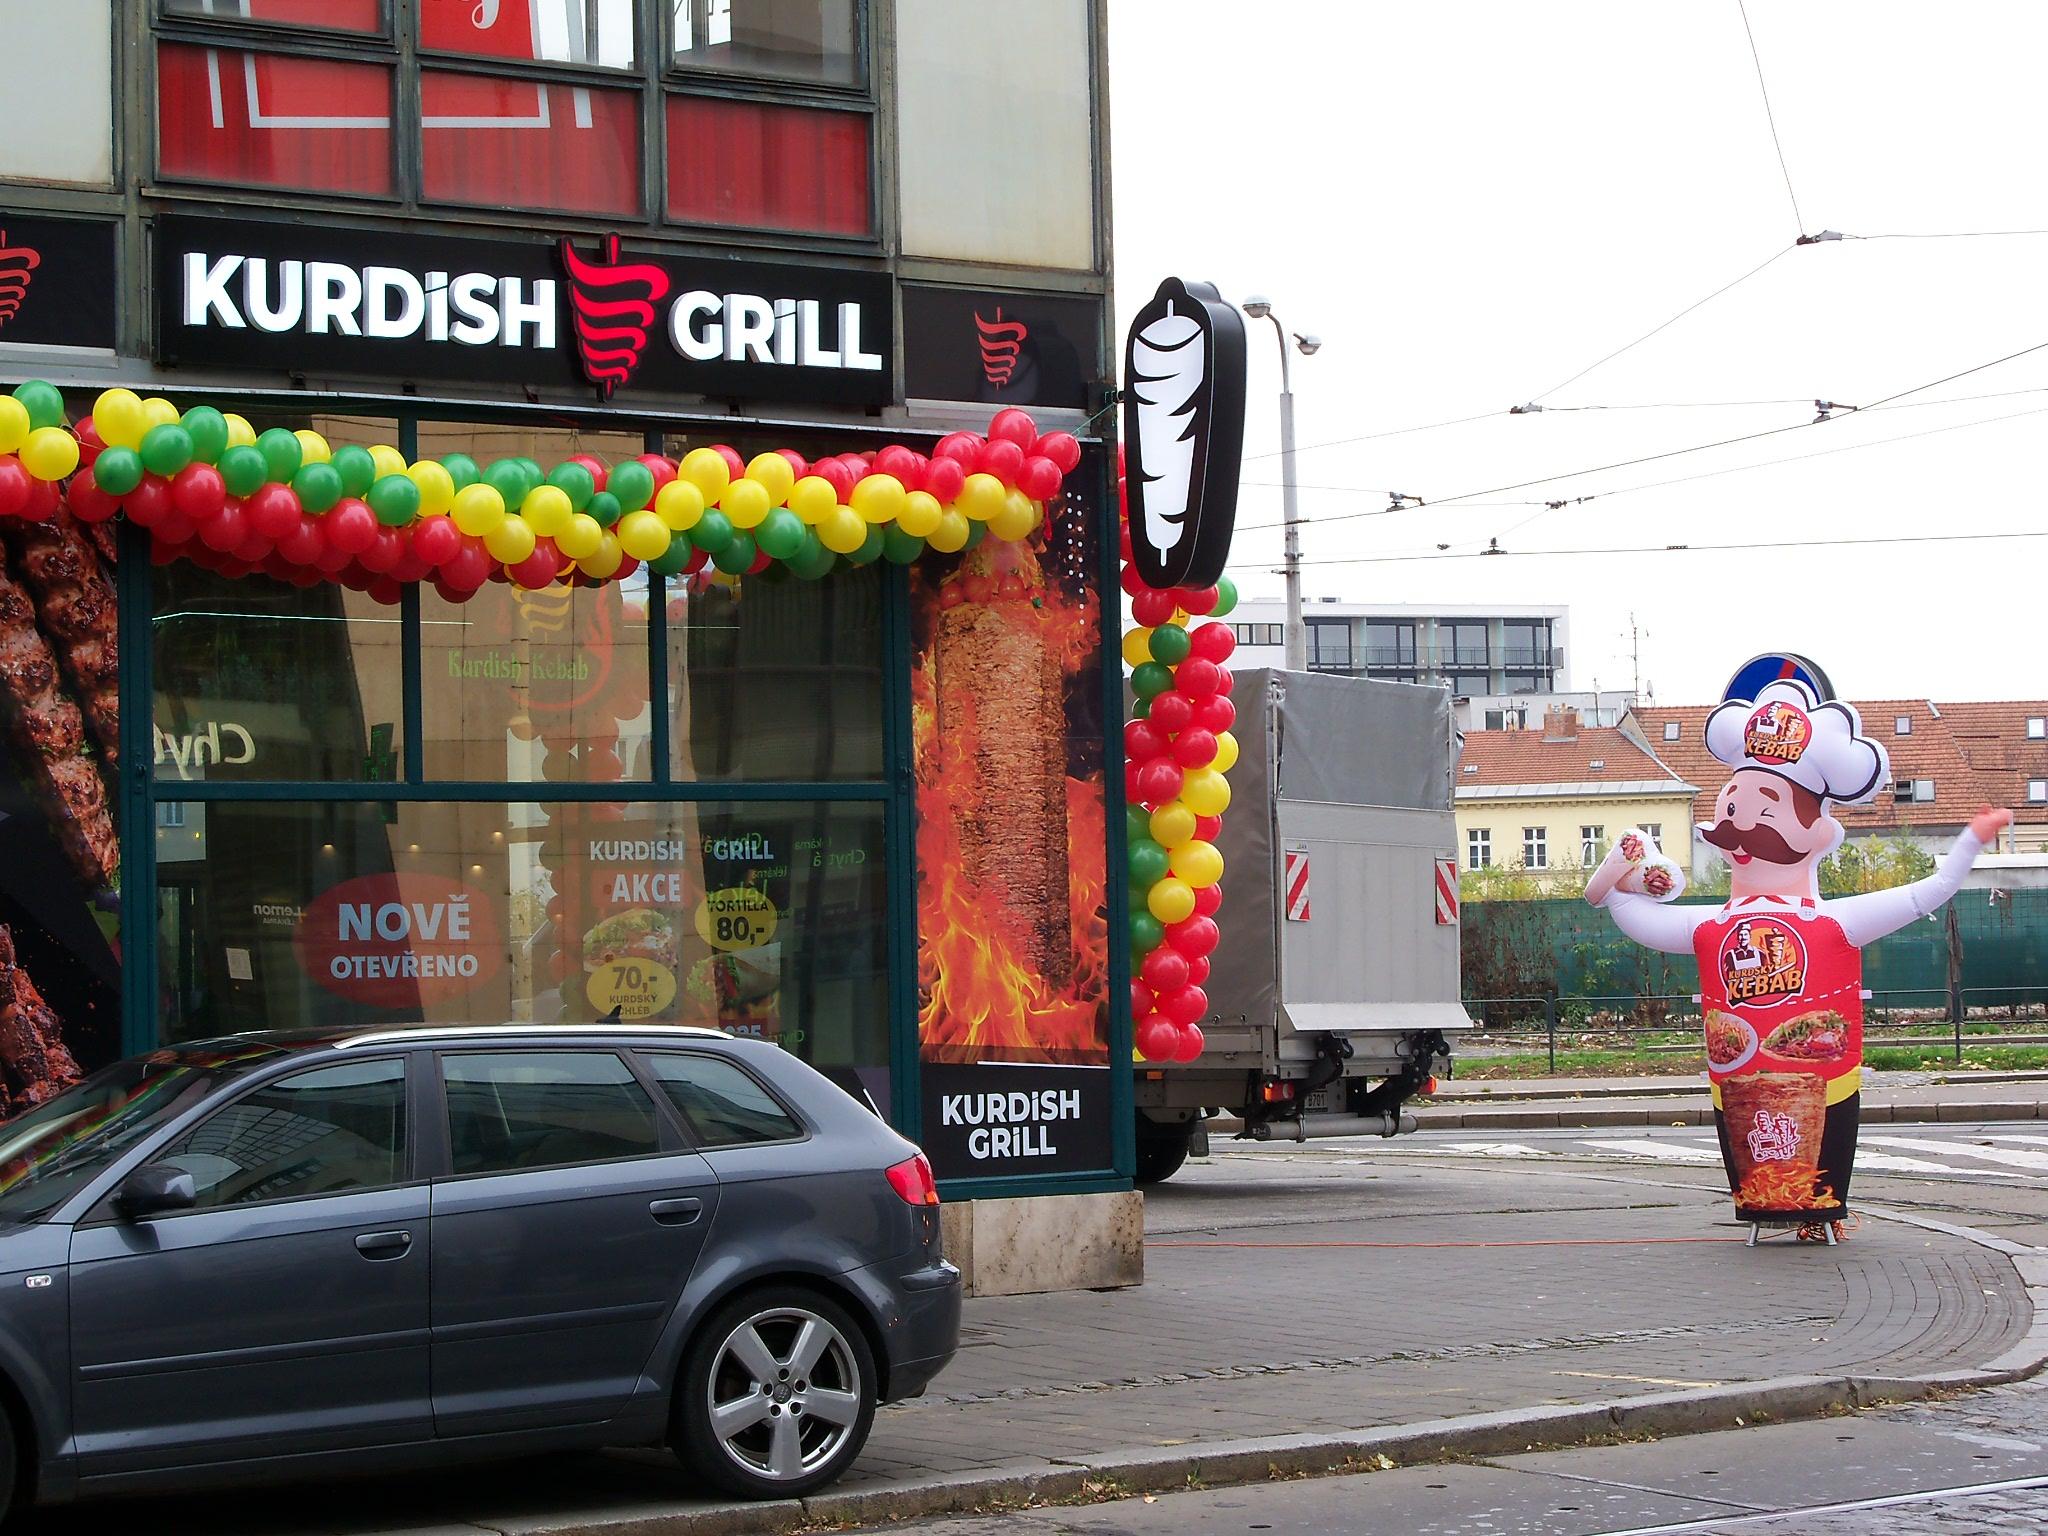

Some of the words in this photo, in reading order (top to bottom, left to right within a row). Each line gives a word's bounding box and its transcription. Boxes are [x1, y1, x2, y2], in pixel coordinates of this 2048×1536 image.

[448, 648, 522, 683] Kurdish
[532, 652, 589, 681] Kebab
[1745, 737, 1803, 760] KEBAB
[611, 873, 681, 903] AKCE
[338, 893, 471, 941] NOVĚ
[709, 900, 769, 912] TORTILLA
[716, 917, 765, 945] 80,-
[330, 949, 479, 979] OTEVŘENO
[612, 966, 658, 993] 70,-
[1728, 969, 1802, 1000] KEBAB
